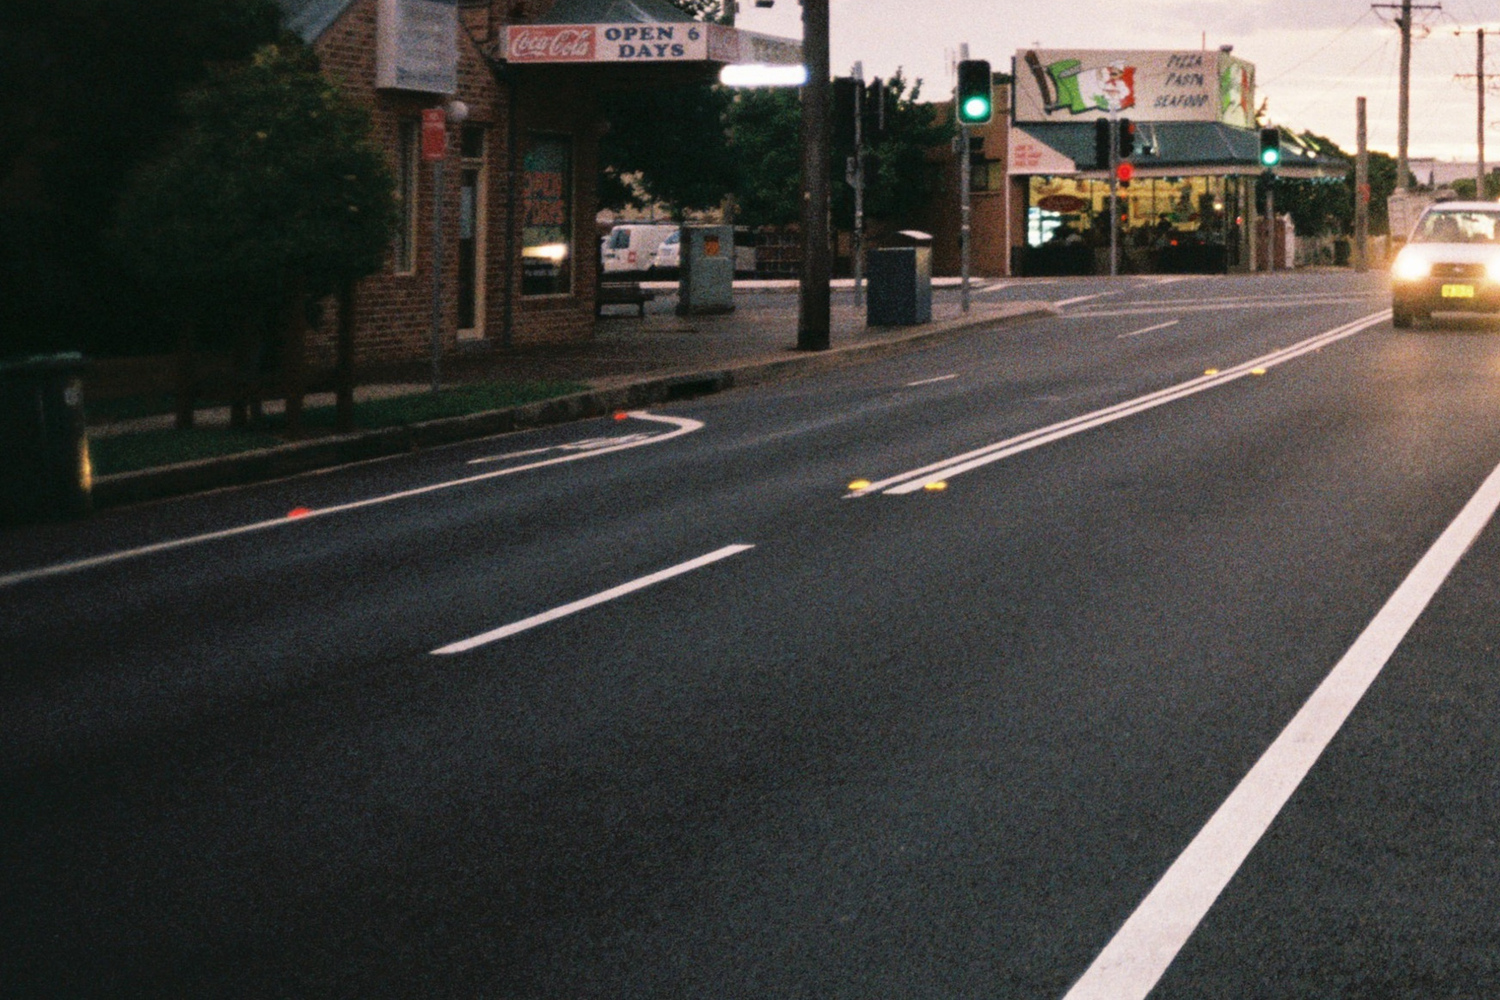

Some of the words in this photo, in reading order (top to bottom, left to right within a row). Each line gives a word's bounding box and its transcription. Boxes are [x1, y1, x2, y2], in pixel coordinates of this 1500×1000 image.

[604, 26, 675, 42] OPEN
[687, 28, 700, 42] 6
[510, 28, 591, 58] Coca-Cola
[618, 43, 685, 59] DAYS
[1166, 53, 1202, 68] PIZZA
[1164, 72, 1204, 87] PASTA
[1153, 93, 1209, 107] SEAFOOD
